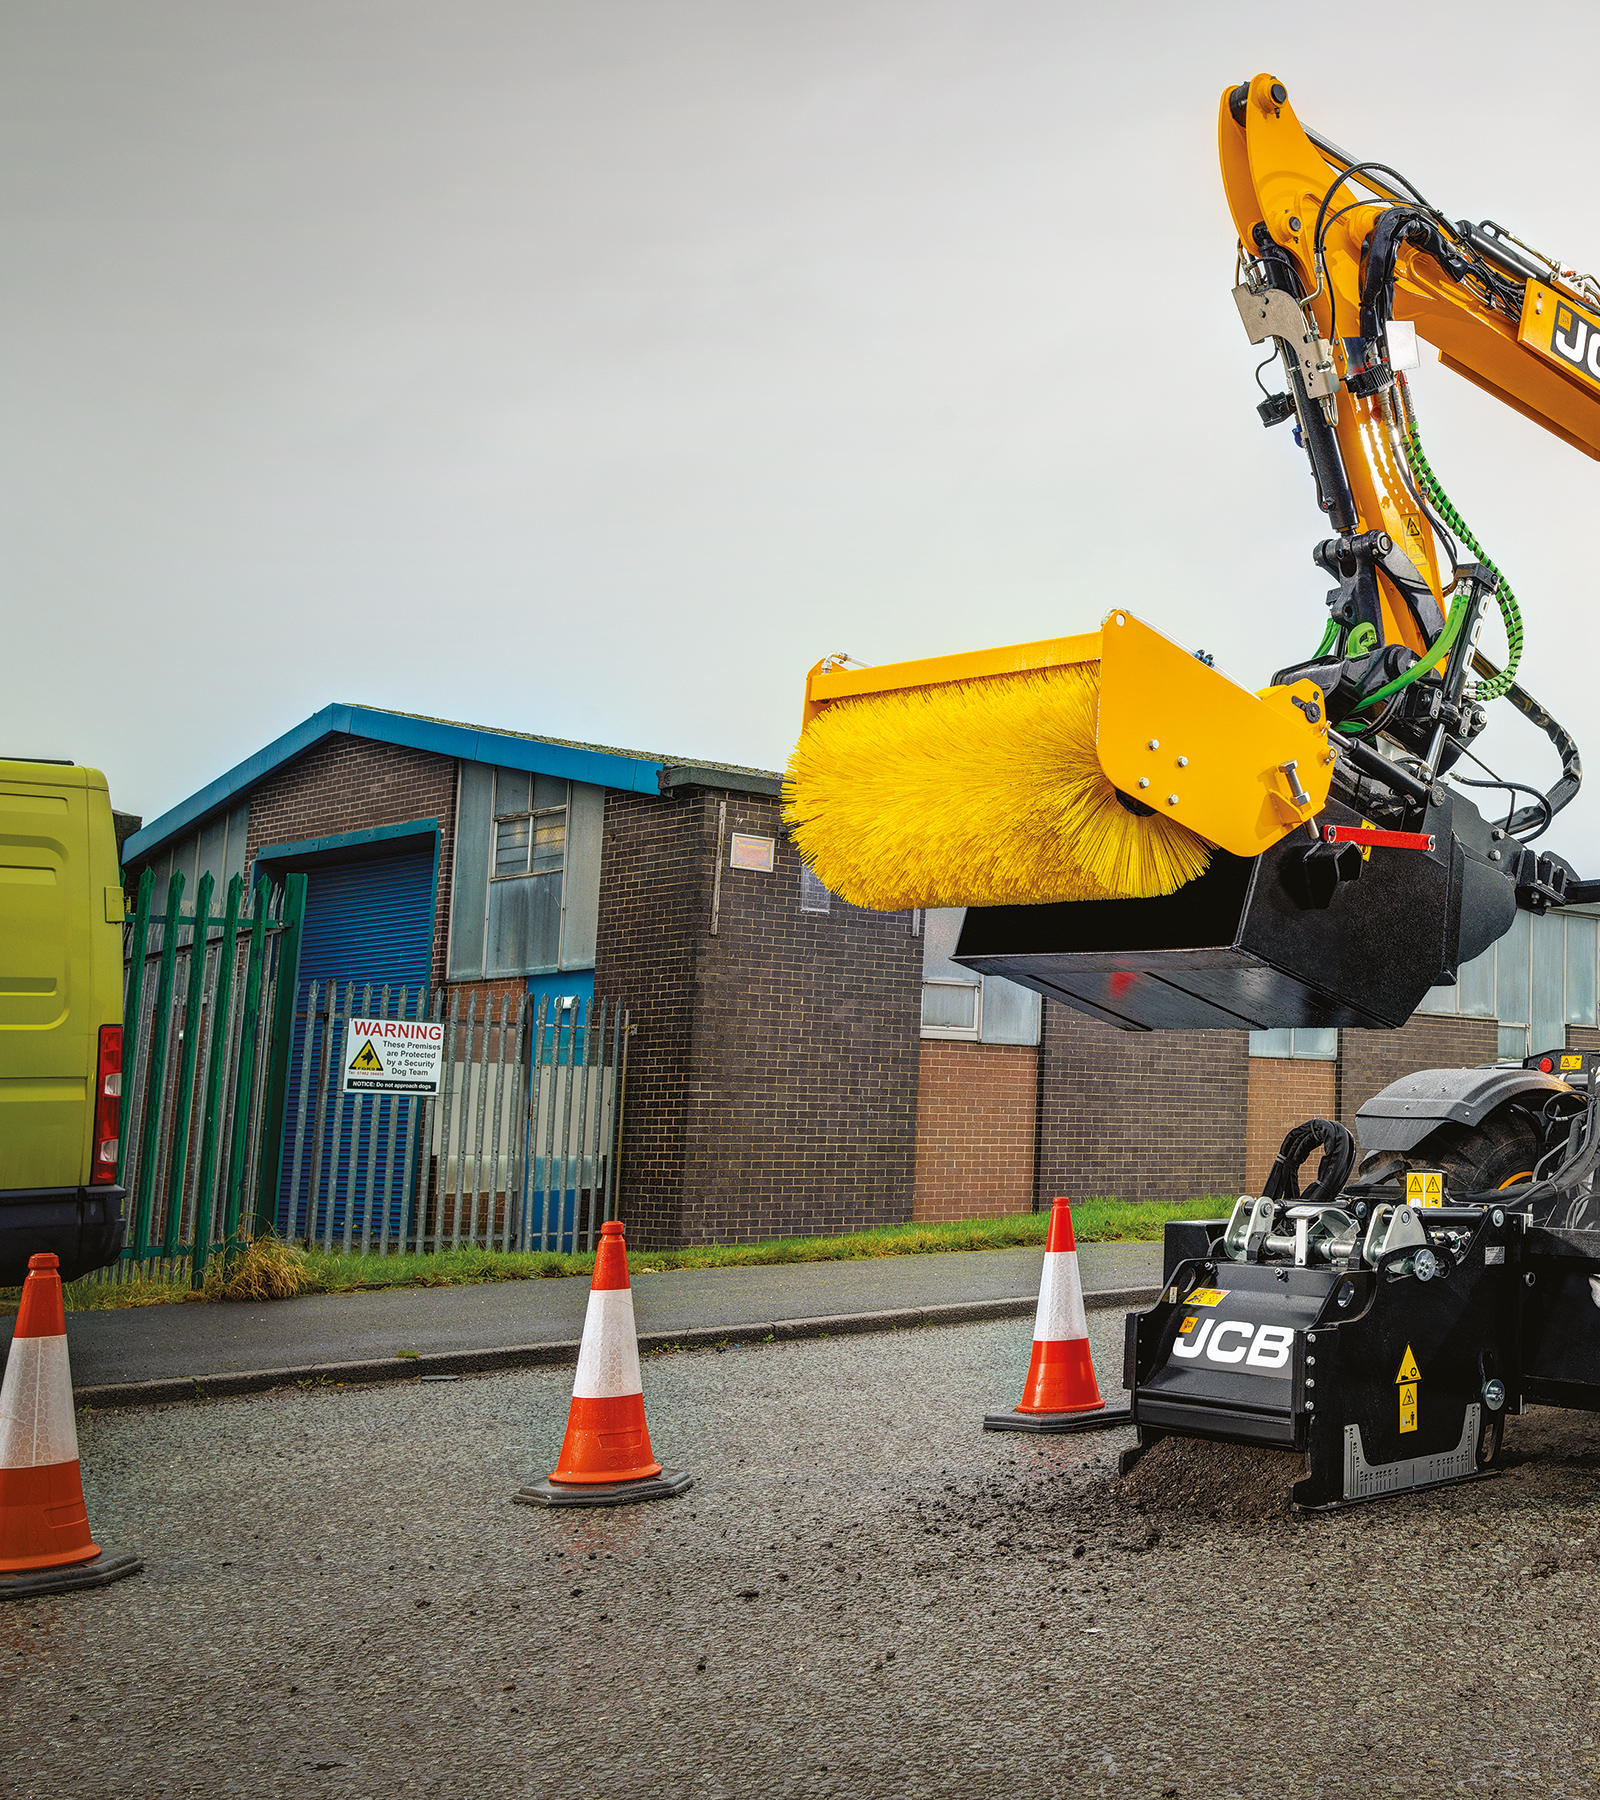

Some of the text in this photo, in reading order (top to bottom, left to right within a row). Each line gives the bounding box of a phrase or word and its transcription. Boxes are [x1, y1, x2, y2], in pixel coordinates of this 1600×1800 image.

[354, 1020, 441, 1040] WARNING
[383, 1040, 441, 1051] These Premises
[400, 1050, 436, 1059] Protected
[386, 1059, 396, 1067] by
[404, 1059, 435, 1069] Security
[391, 1067, 428, 1077] Dog Team
[1172, 1318, 1295, 1369] JCB
